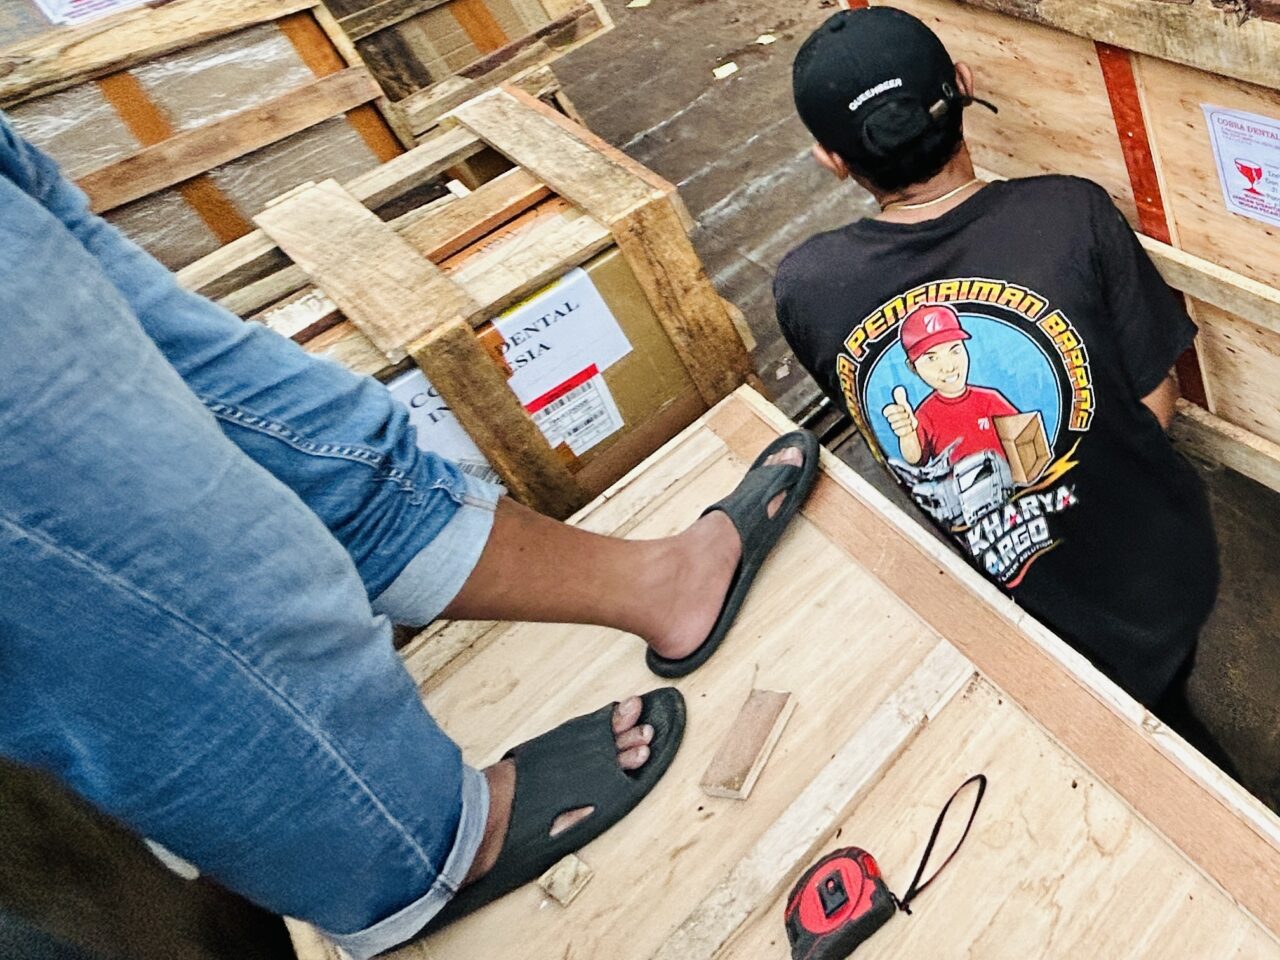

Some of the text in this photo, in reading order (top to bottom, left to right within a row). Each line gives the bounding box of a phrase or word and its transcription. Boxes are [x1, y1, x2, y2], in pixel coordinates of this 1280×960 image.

[1246, 125, 1280, 141] DENTAL
[844, 278, 1095, 431] PENGIRIMAN BARANG
[966, 485, 1078, 556] KHARYA
